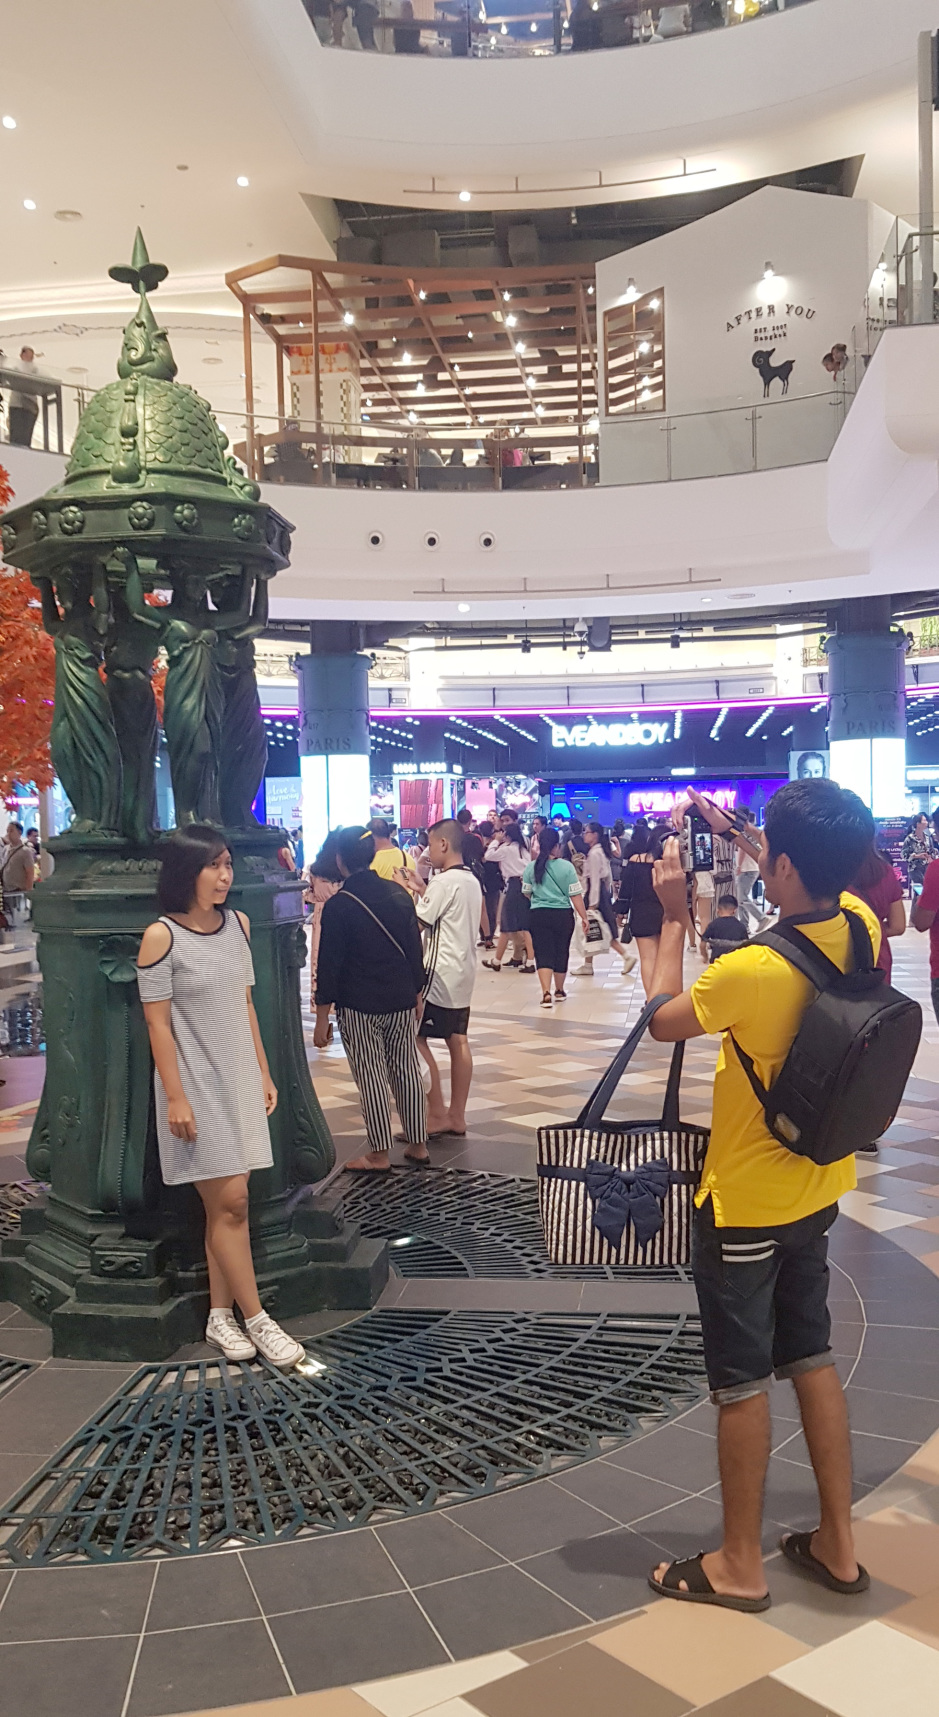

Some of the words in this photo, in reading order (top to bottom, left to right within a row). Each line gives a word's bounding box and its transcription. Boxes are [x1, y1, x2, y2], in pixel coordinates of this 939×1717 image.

[726, 304, 776, 332] AFTER
[785, 303, 816, 320] YOU
[772, 323, 787, 331] 2007
[754, 331, 787, 342] Bangkok
[846, 720, 896, 735] PARIS
[306, 737, 352, 751] PARIS
